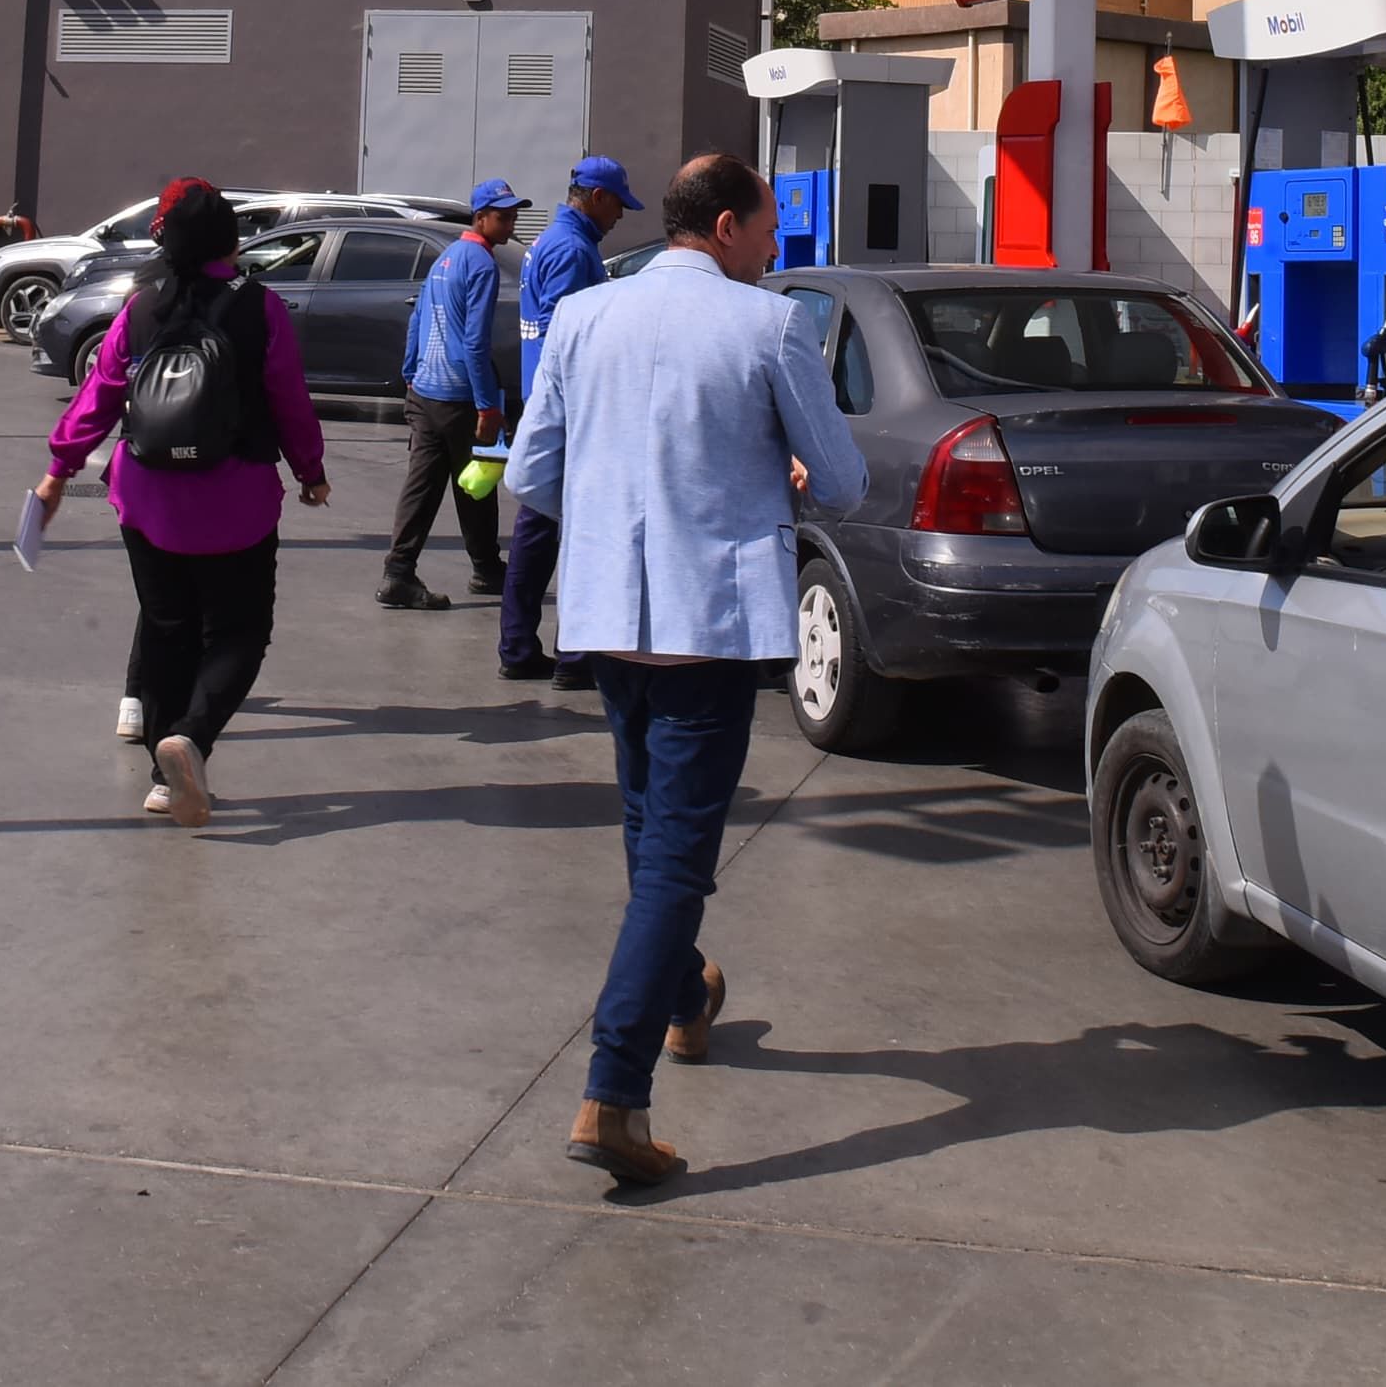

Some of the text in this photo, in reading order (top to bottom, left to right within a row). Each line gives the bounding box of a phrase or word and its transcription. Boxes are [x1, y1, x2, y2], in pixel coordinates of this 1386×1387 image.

[1266, 12, 1305, 36] Mobil
[171, 446, 198, 459] NIKE
[1019, 465, 1065, 476] OPEL
